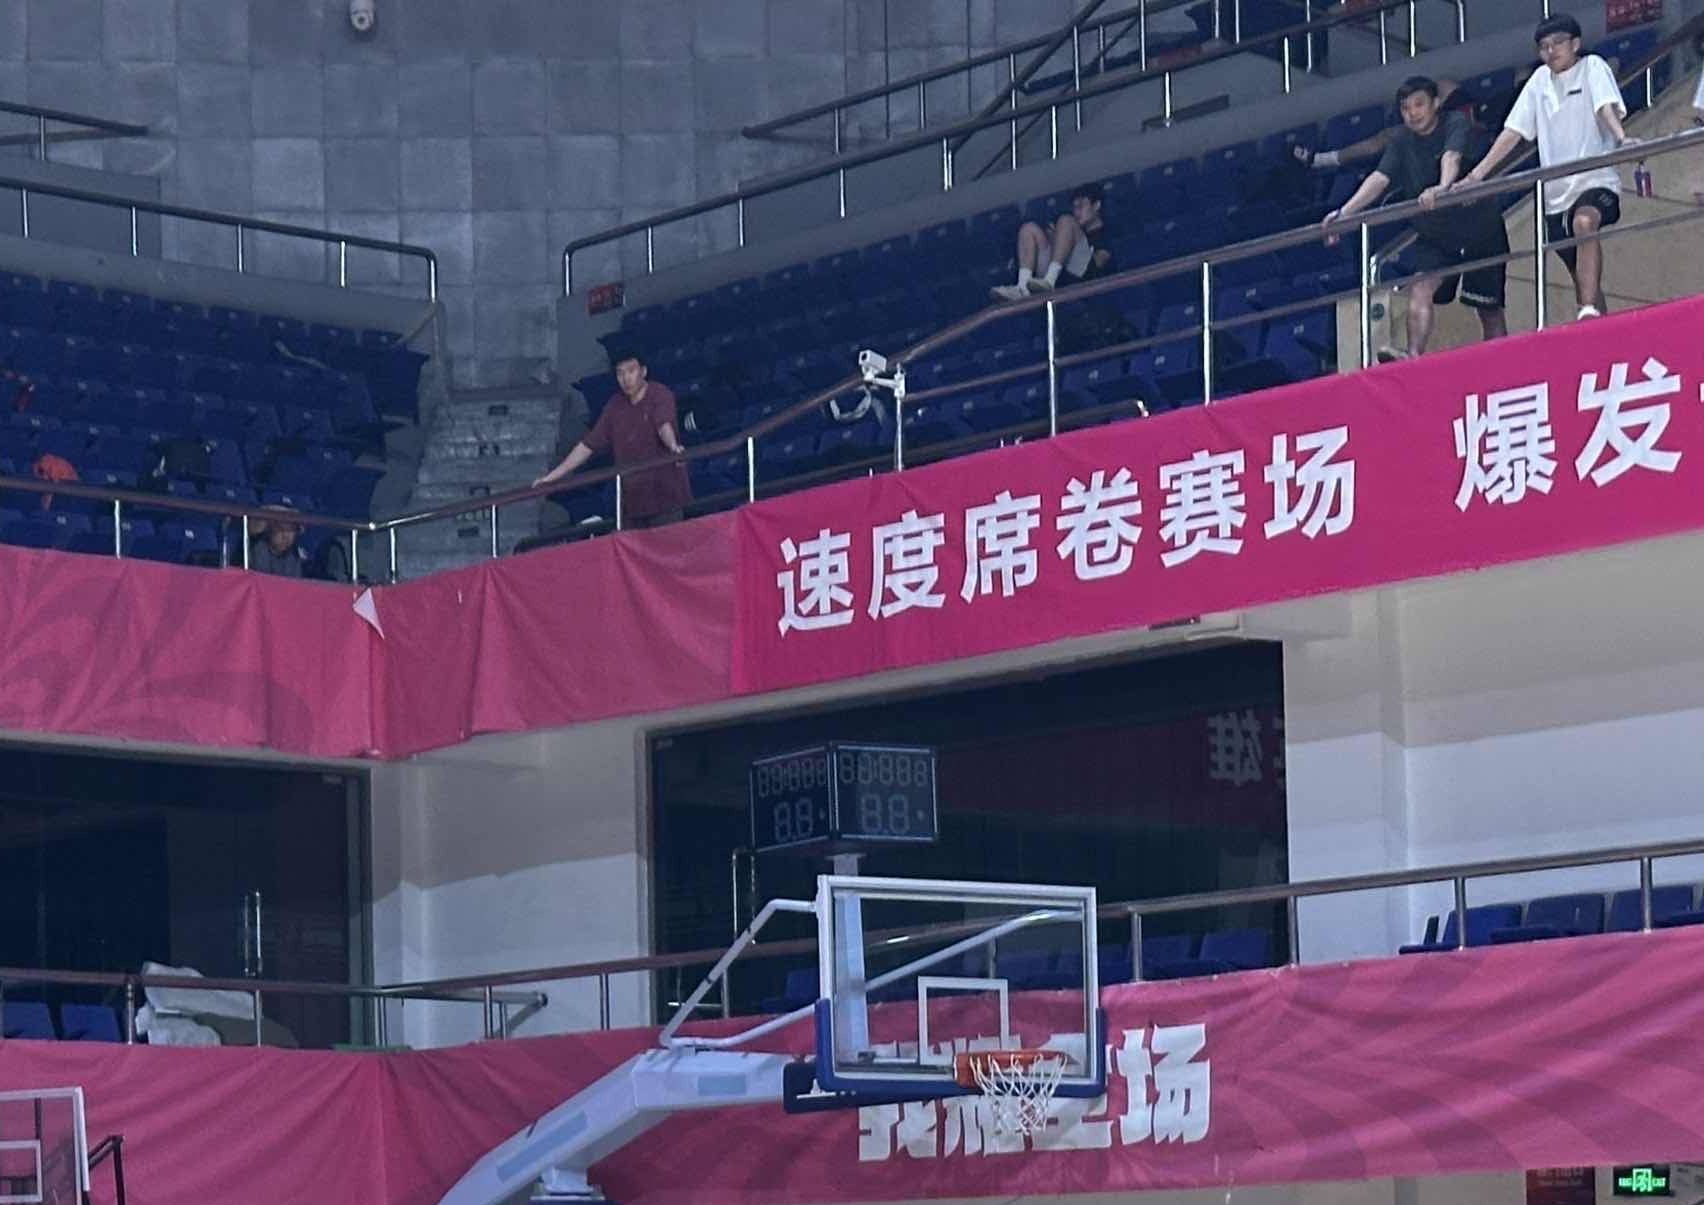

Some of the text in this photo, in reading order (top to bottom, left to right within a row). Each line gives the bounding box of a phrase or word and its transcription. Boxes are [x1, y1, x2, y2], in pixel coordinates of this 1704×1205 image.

[776, 356, 1704, 639] 速度席卷赛场 爆发
